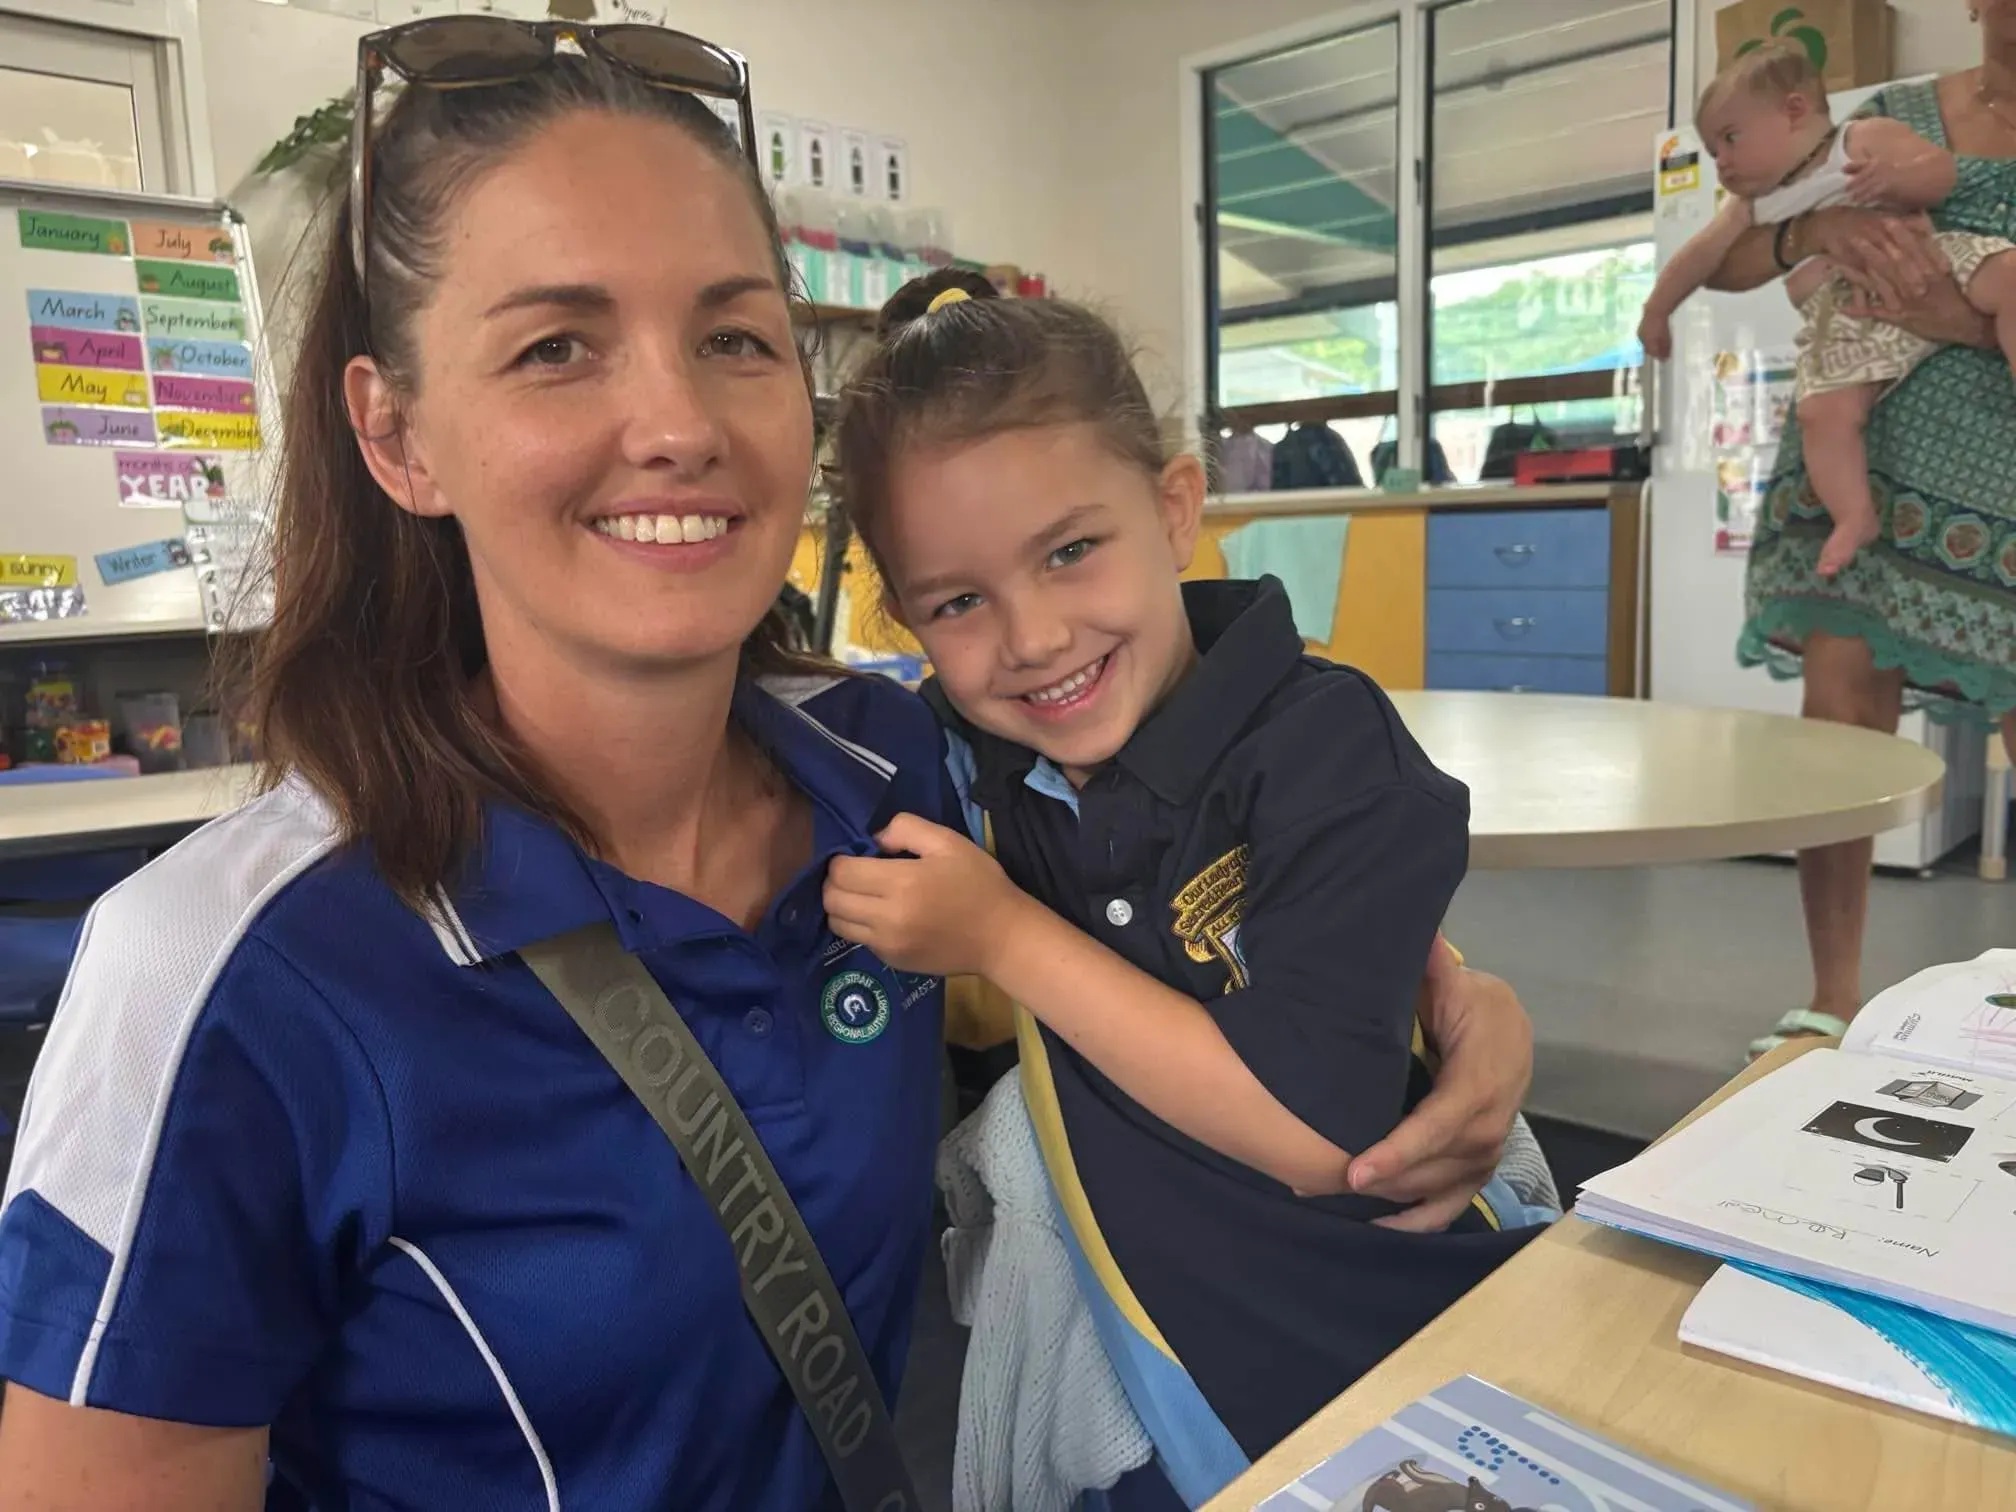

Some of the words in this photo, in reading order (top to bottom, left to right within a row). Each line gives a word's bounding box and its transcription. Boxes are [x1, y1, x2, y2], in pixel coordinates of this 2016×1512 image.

[26, 217, 101, 249] January
[156, 229, 192, 258] July
[169, 270, 232, 296] August
[41, 297, 105, 320] March
[146, 304, 237, 334] September
[78, 338, 125, 365] April
[180, 345, 248, 367] October
[60, 373, 107, 404] May
[98, 418, 140, 436] June
[119, 474, 210, 501] YEAR
[594, 983, 808, 1295] COUNTRY
[776, 1289, 873, 1459] ROAD
[1878, 1236, 1940, 1258] Name:
